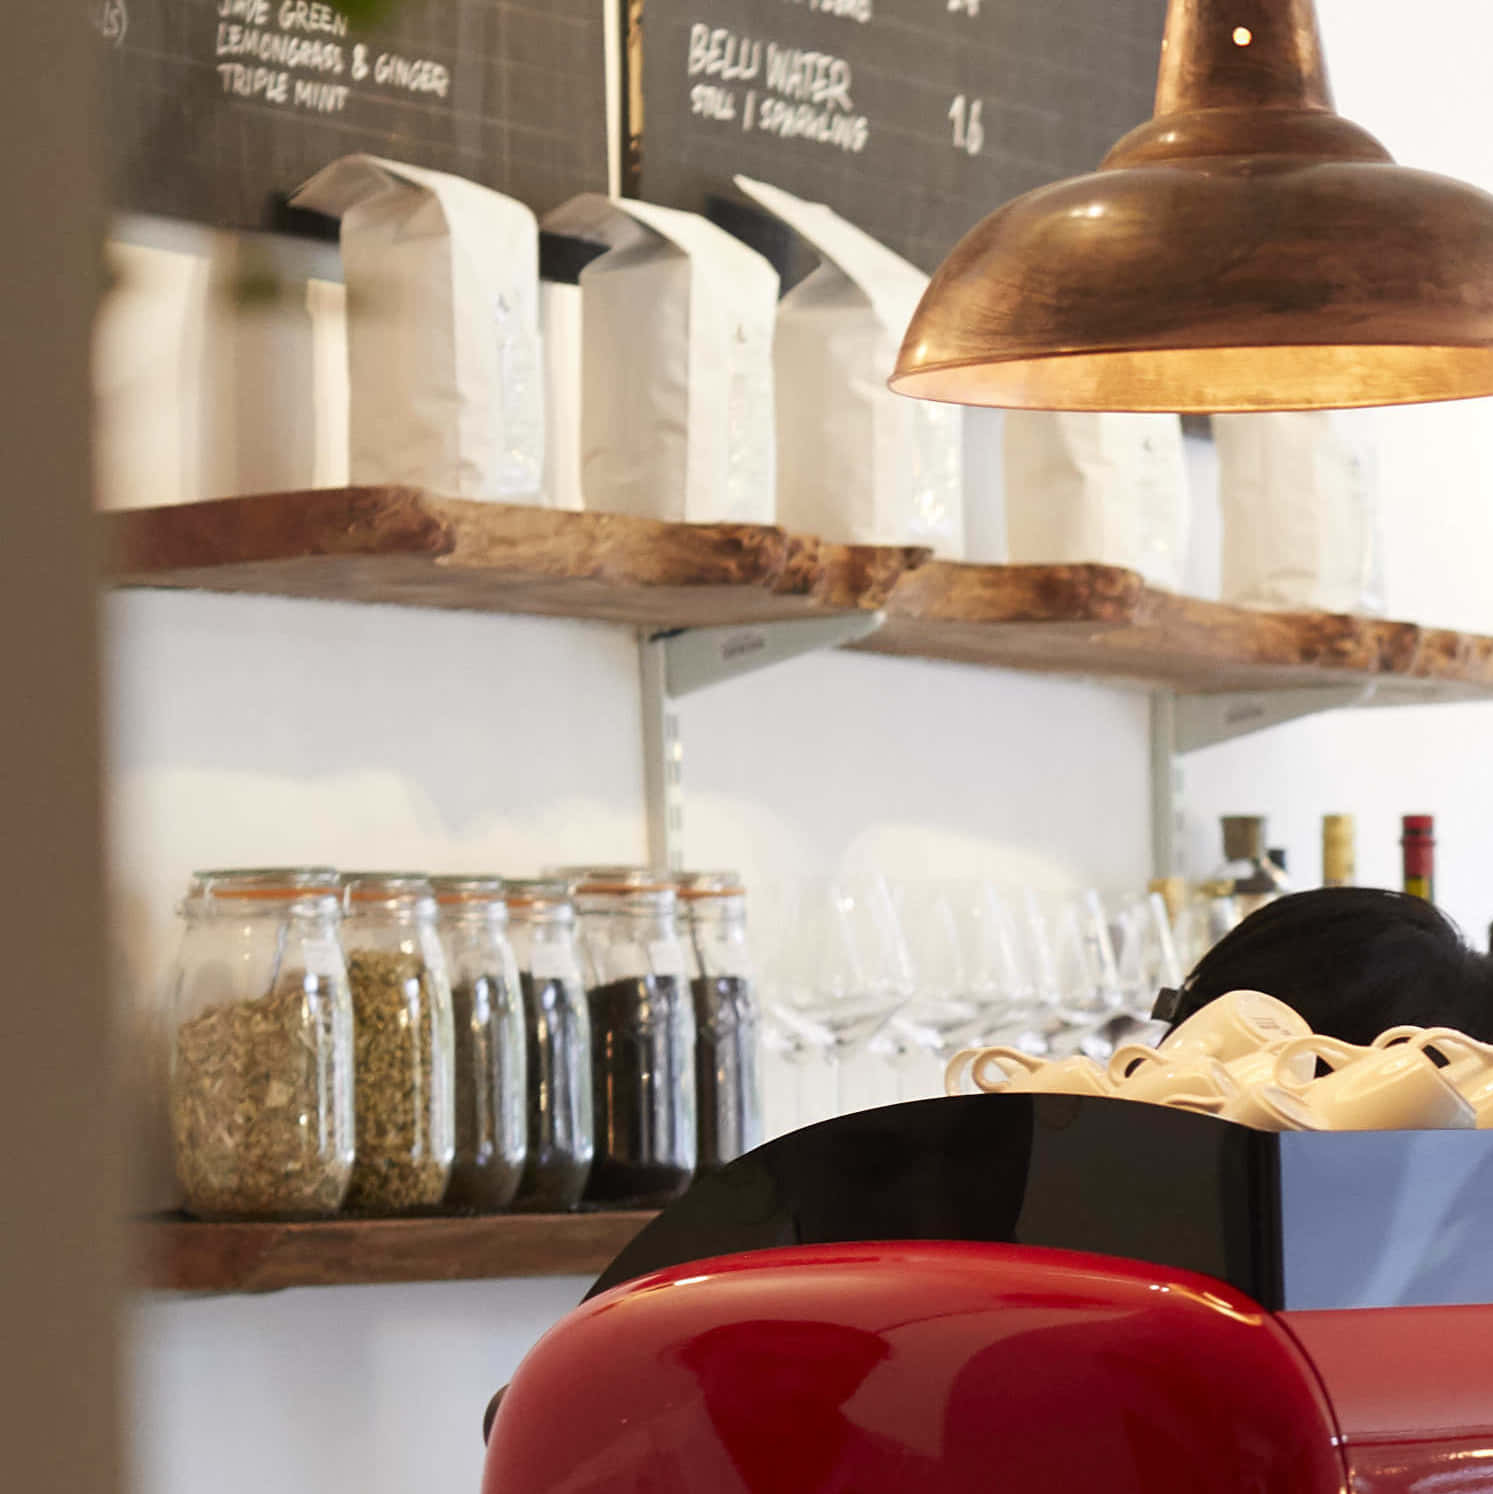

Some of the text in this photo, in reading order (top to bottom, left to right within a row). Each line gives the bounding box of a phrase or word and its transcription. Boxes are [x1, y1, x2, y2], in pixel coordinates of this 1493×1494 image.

[279, 0, 349, 37] GREEN
[216, 22, 343, 74] LEMONGRASS
[374, 52, 450, 97] GINGER
[216, 63, 350, 112] TRIPLE MINT
[767, 42, 854, 111] WATER
